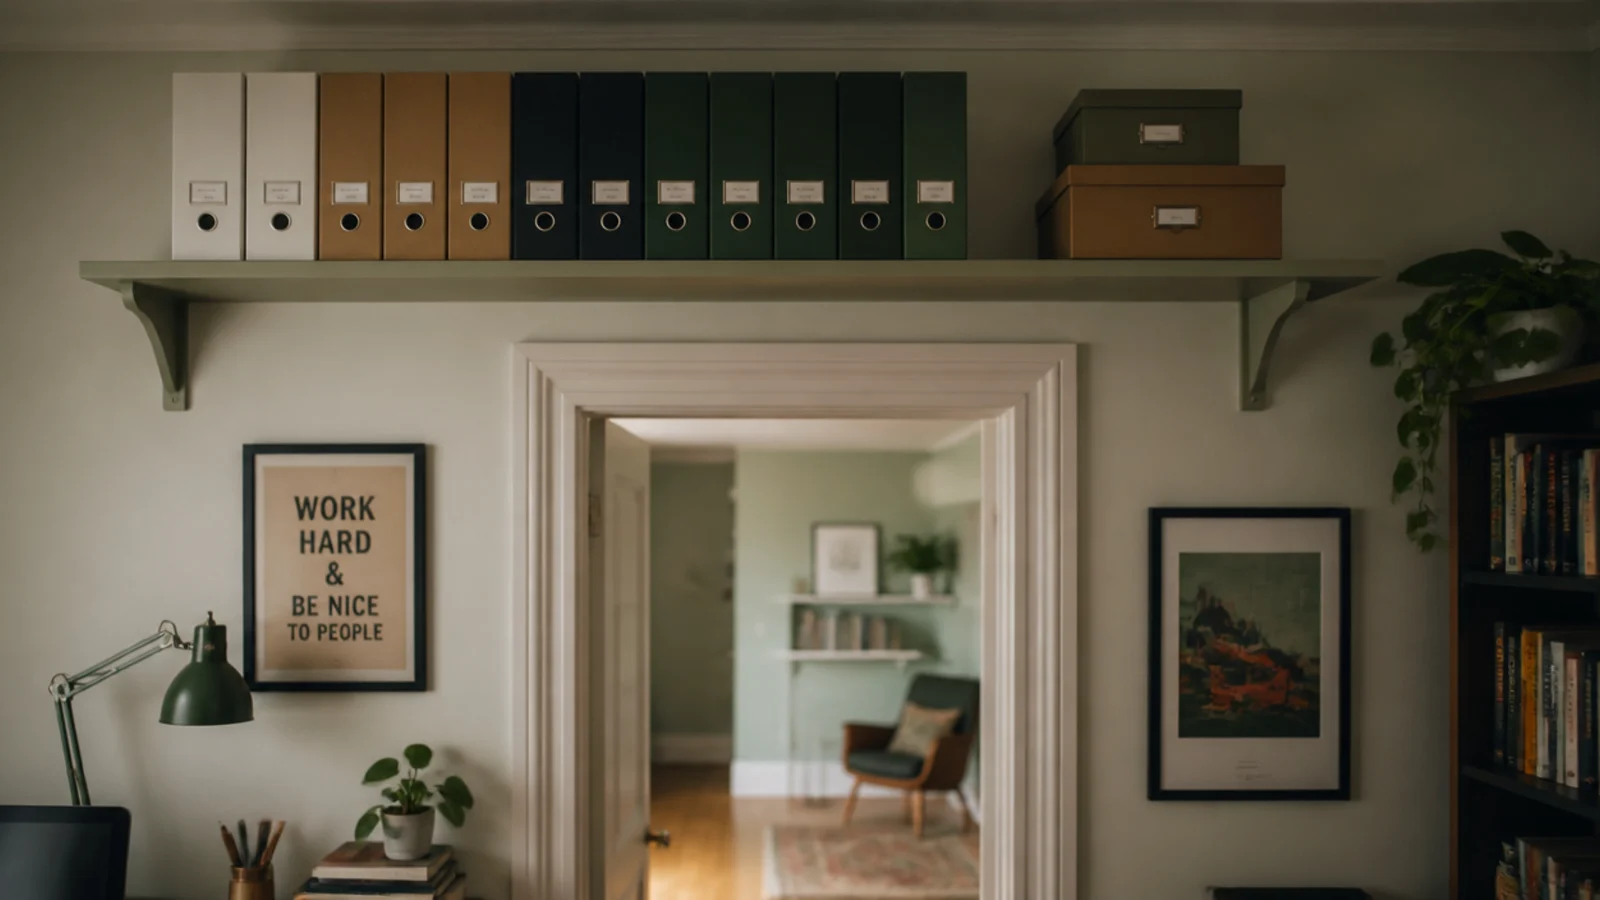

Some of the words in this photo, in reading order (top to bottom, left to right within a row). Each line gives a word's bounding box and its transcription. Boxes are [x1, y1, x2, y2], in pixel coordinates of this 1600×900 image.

[294, 496, 376, 521] WORK
[300, 530, 372, 554] HARD
[325, 561, 344, 586] &
[292, 595, 318, 617] BE
[328, 595, 379, 617] NICE
[287, 623, 310, 641] TO
[317, 623, 383, 641] PEOPLE
